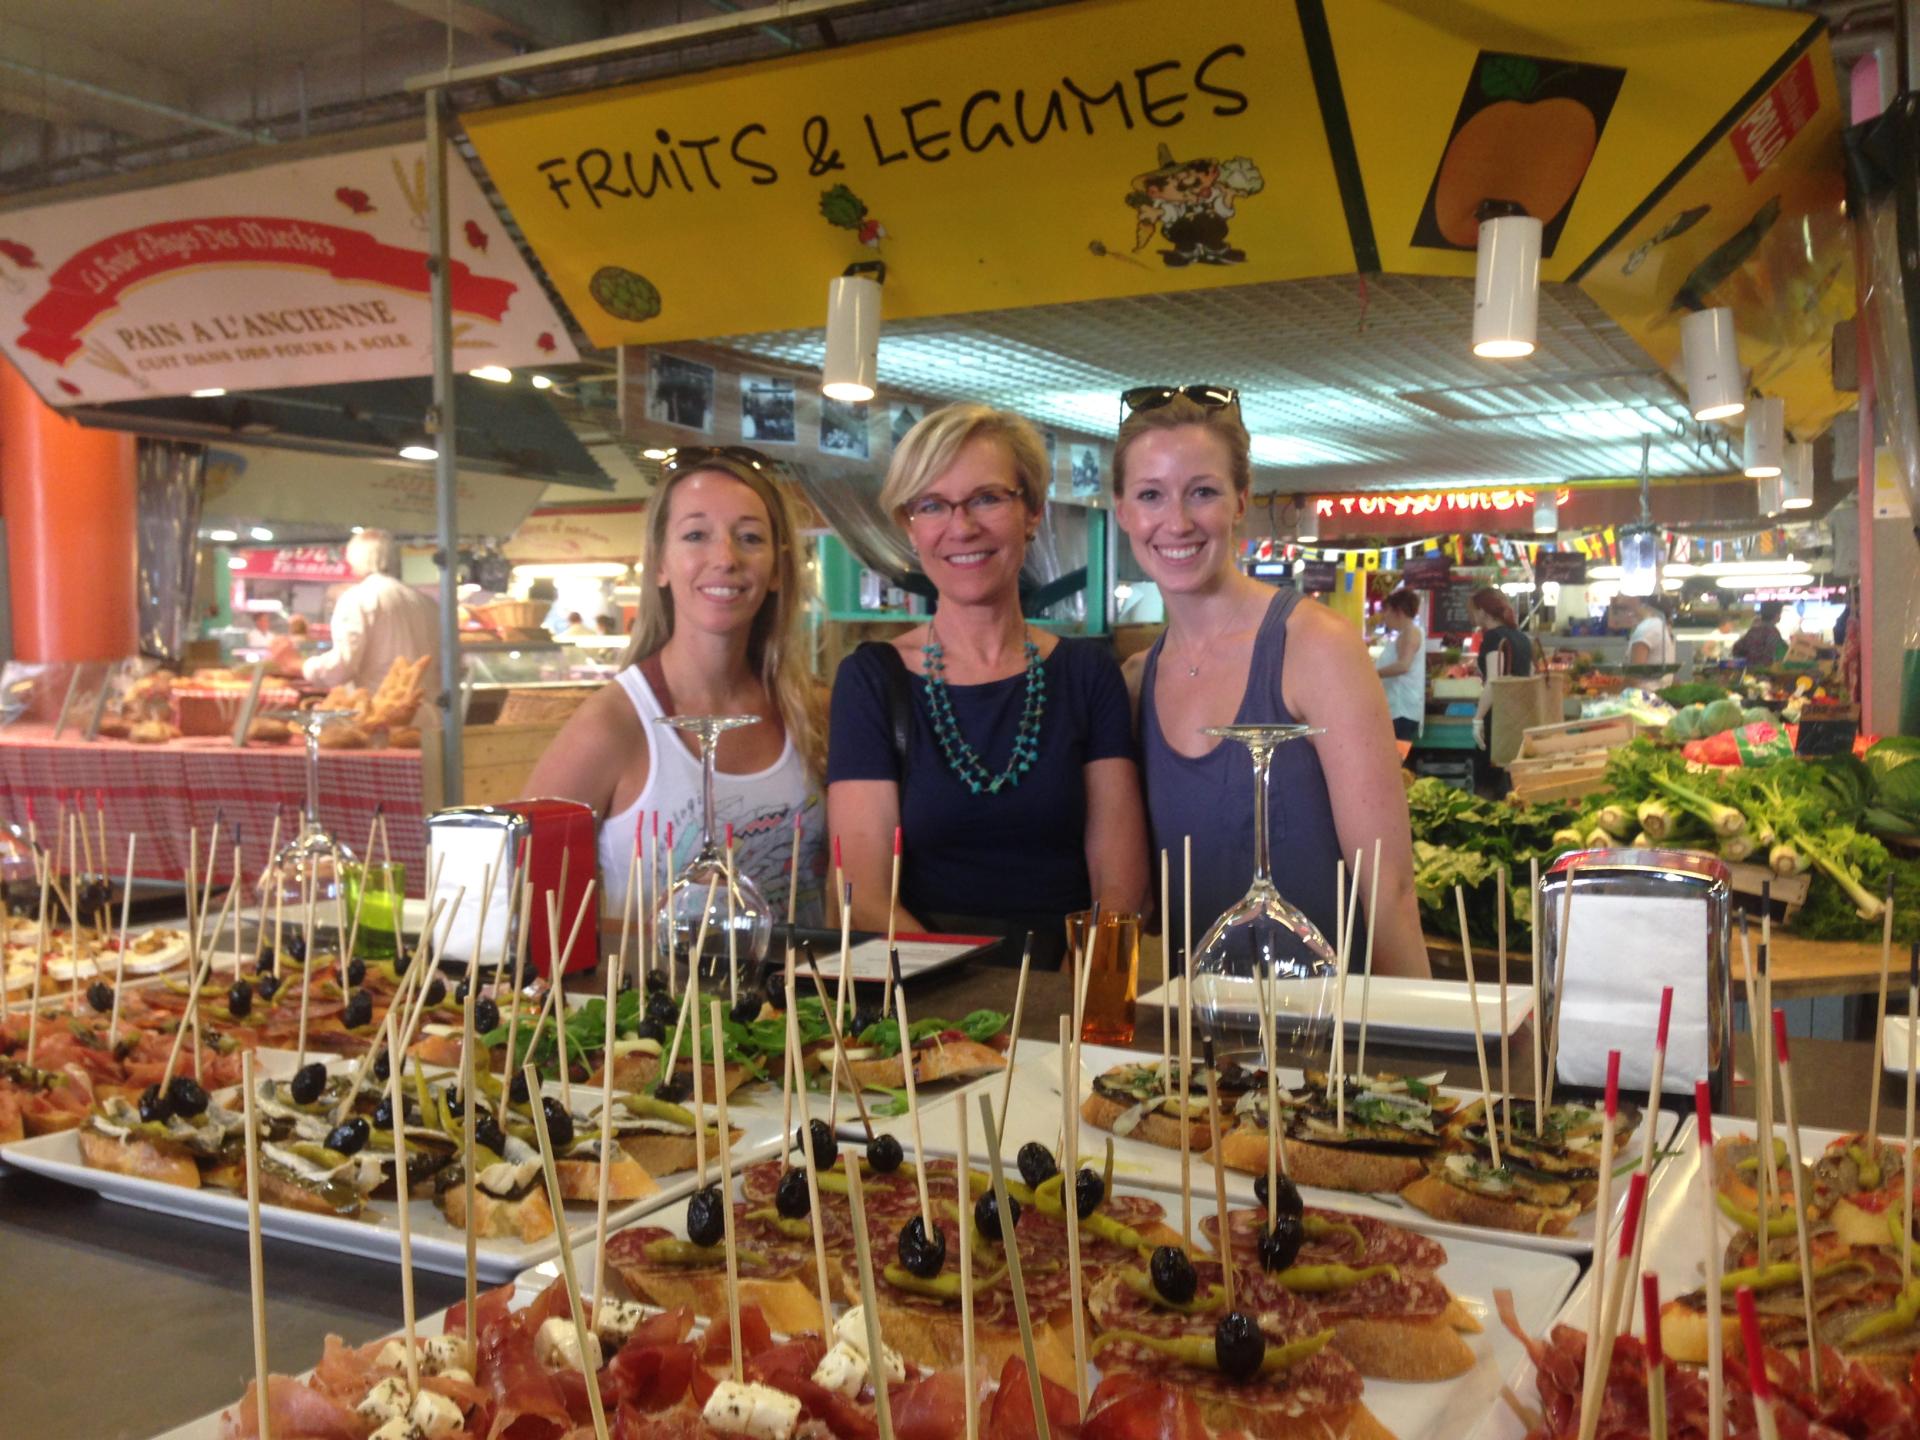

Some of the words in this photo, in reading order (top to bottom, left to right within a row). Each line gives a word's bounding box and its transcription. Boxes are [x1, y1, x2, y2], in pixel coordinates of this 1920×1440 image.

[801, 115, 845, 177] &
[864, 43, 1249, 166] LEGUMES
[116, 321, 184, 350] PAIN
[191, 320, 215, 343] A
[212, 299, 397, 340] L'ANCIENNE
